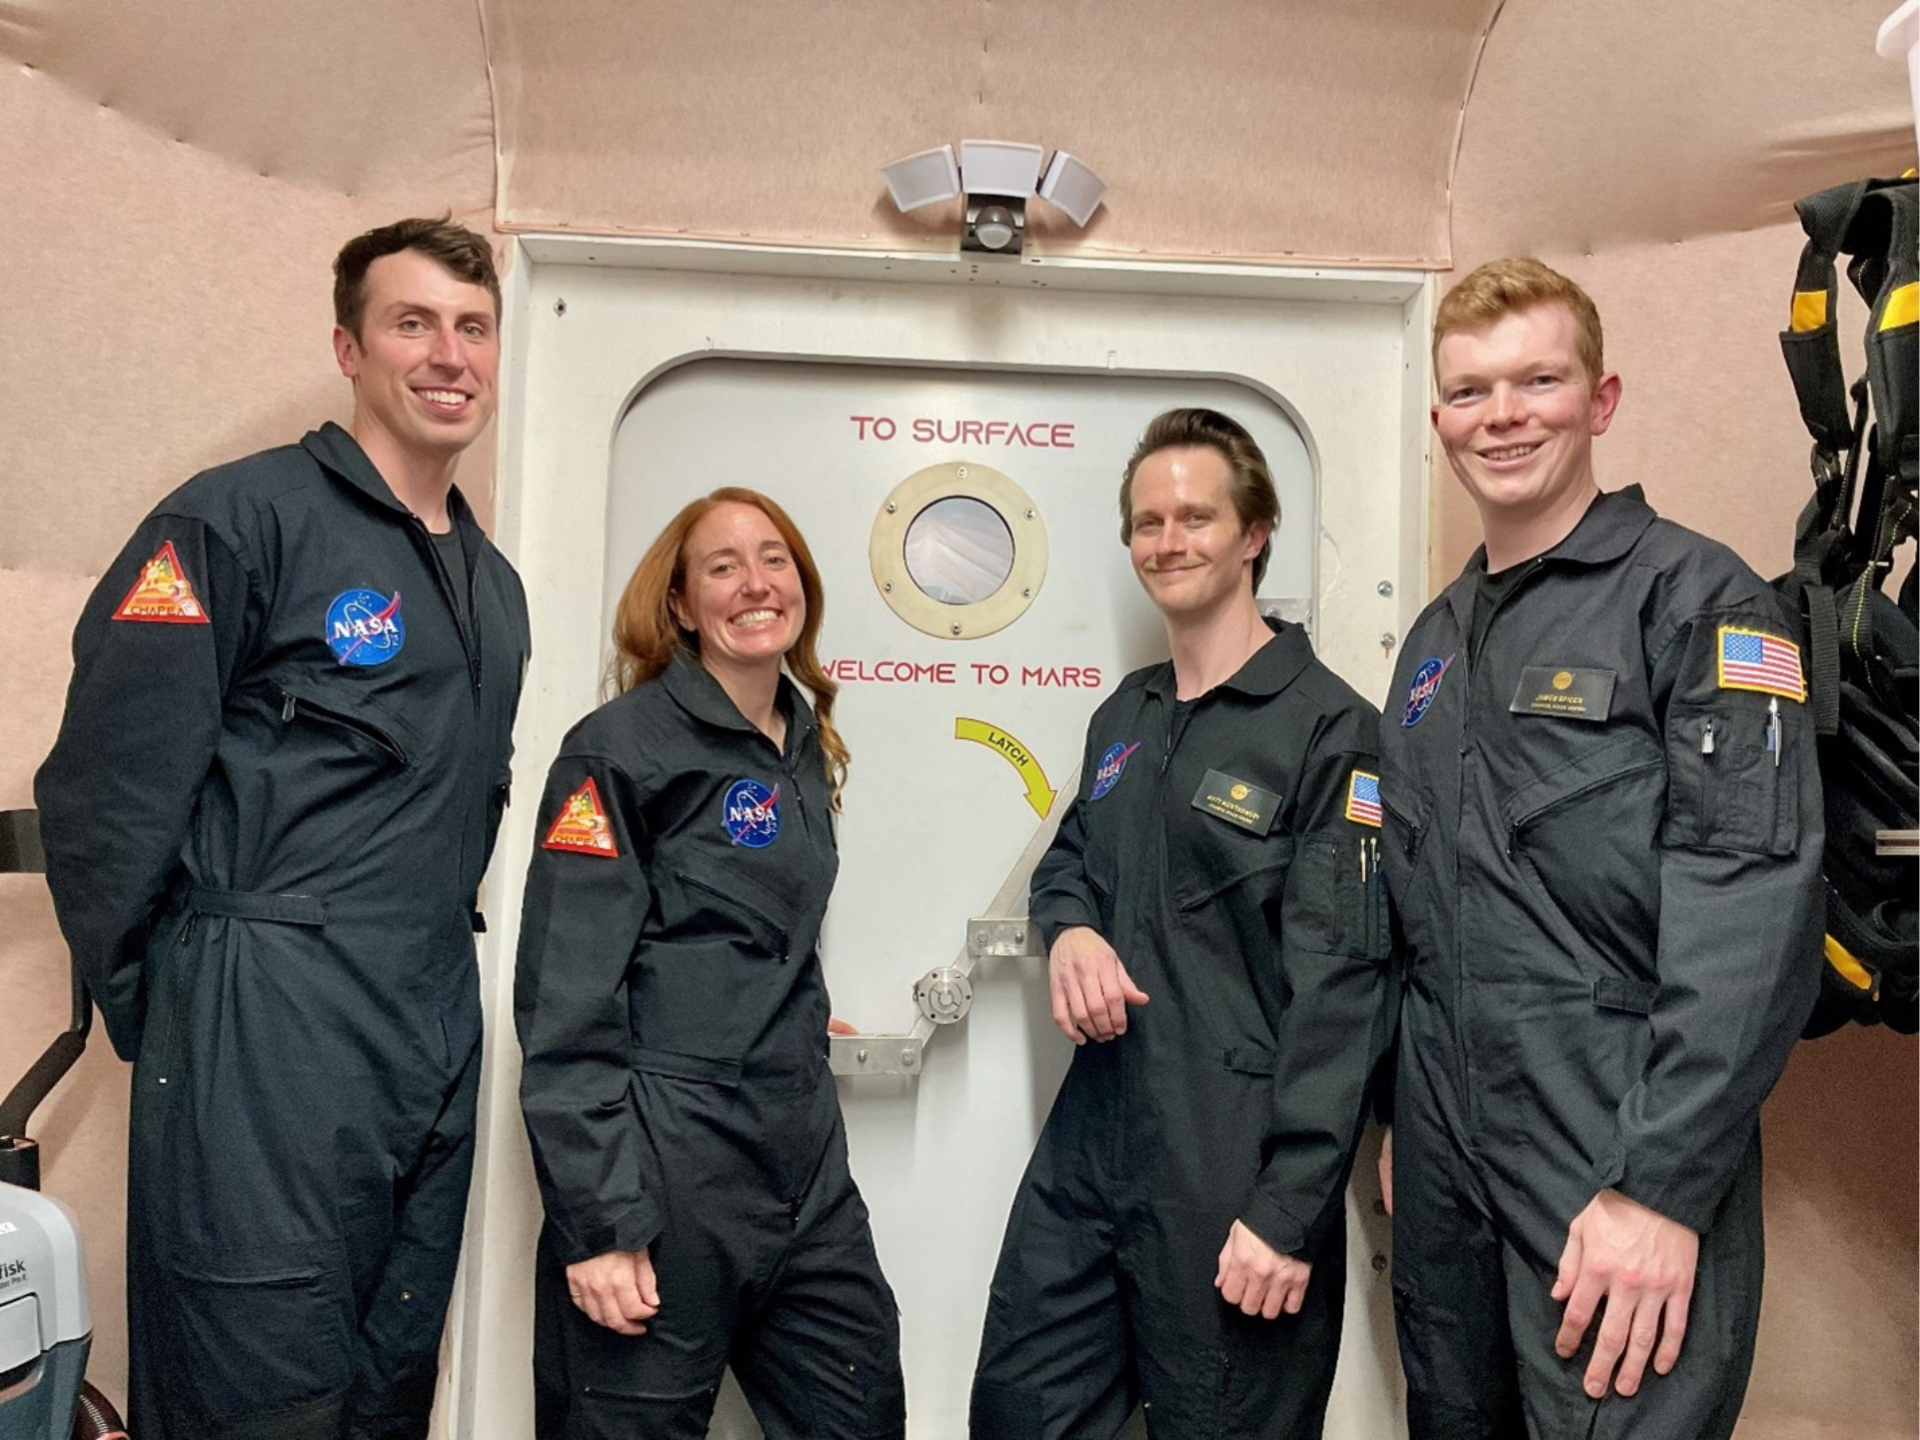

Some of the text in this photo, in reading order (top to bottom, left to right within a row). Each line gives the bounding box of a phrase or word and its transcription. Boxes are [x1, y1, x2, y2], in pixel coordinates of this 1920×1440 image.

[850, 416, 1075, 448] TO SURFACE
[130, 605, 185, 616] CHAPEA
[333, 617, 398, 639] NASA
[970, 663, 1009, 685] TO
[1021, 666, 1102, 688] MARS
[988, 731, 1030, 767] LATCH
[730, 806, 776, 822] NASA
